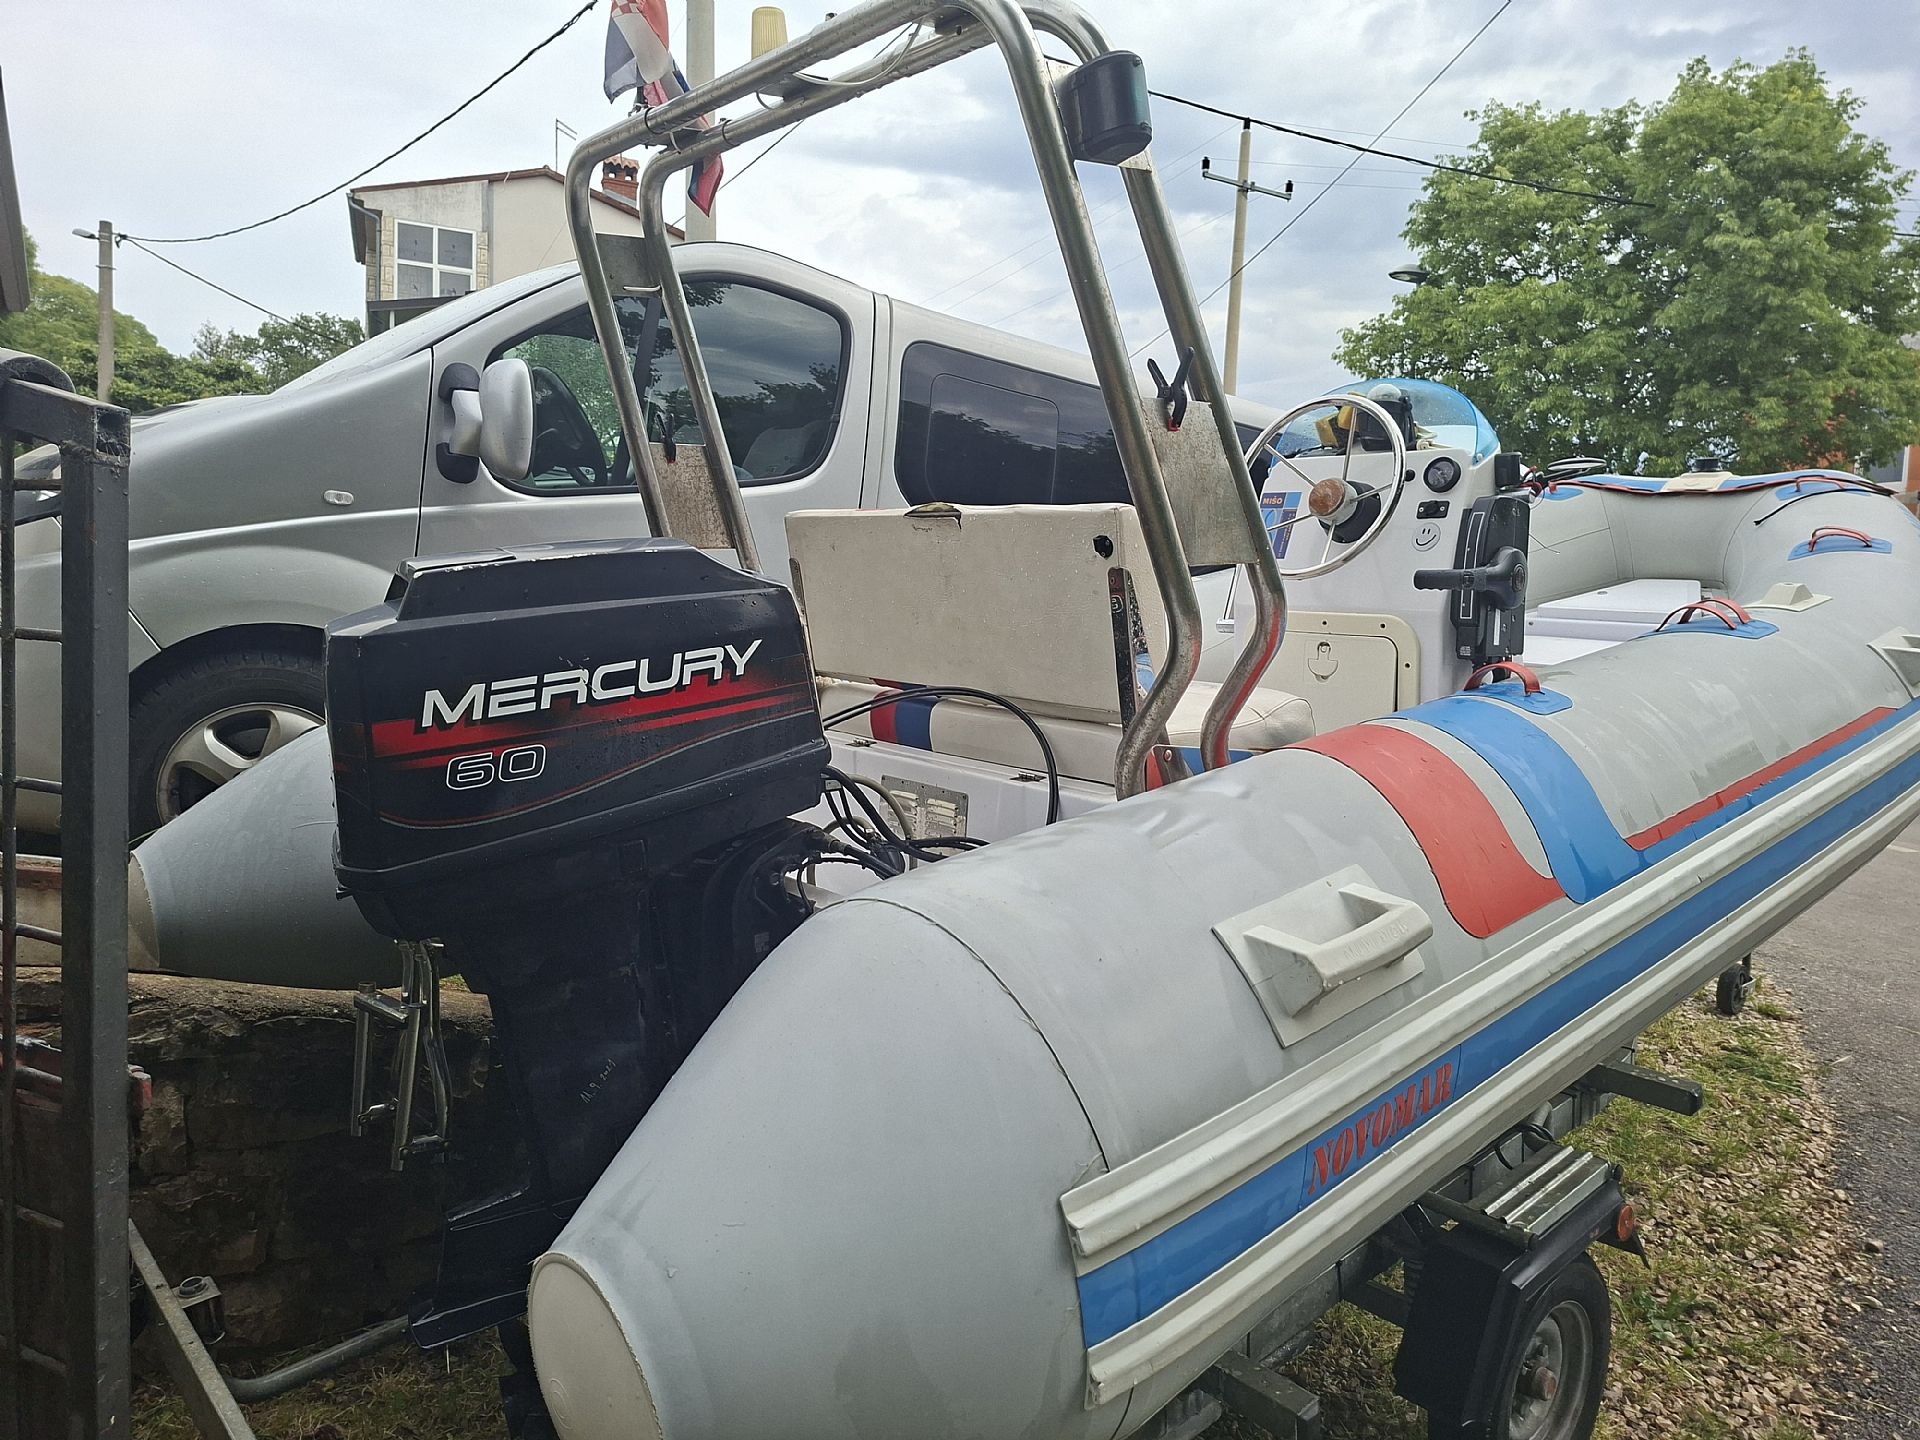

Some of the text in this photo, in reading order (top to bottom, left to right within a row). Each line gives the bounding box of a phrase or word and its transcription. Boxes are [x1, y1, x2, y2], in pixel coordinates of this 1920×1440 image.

[1262, 495, 1283, 505] MIŠO
[420, 638, 763, 729] MERCURY
[445, 743, 546, 791] 60
[1307, 1062, 1453, 1196] NOVOMAR
